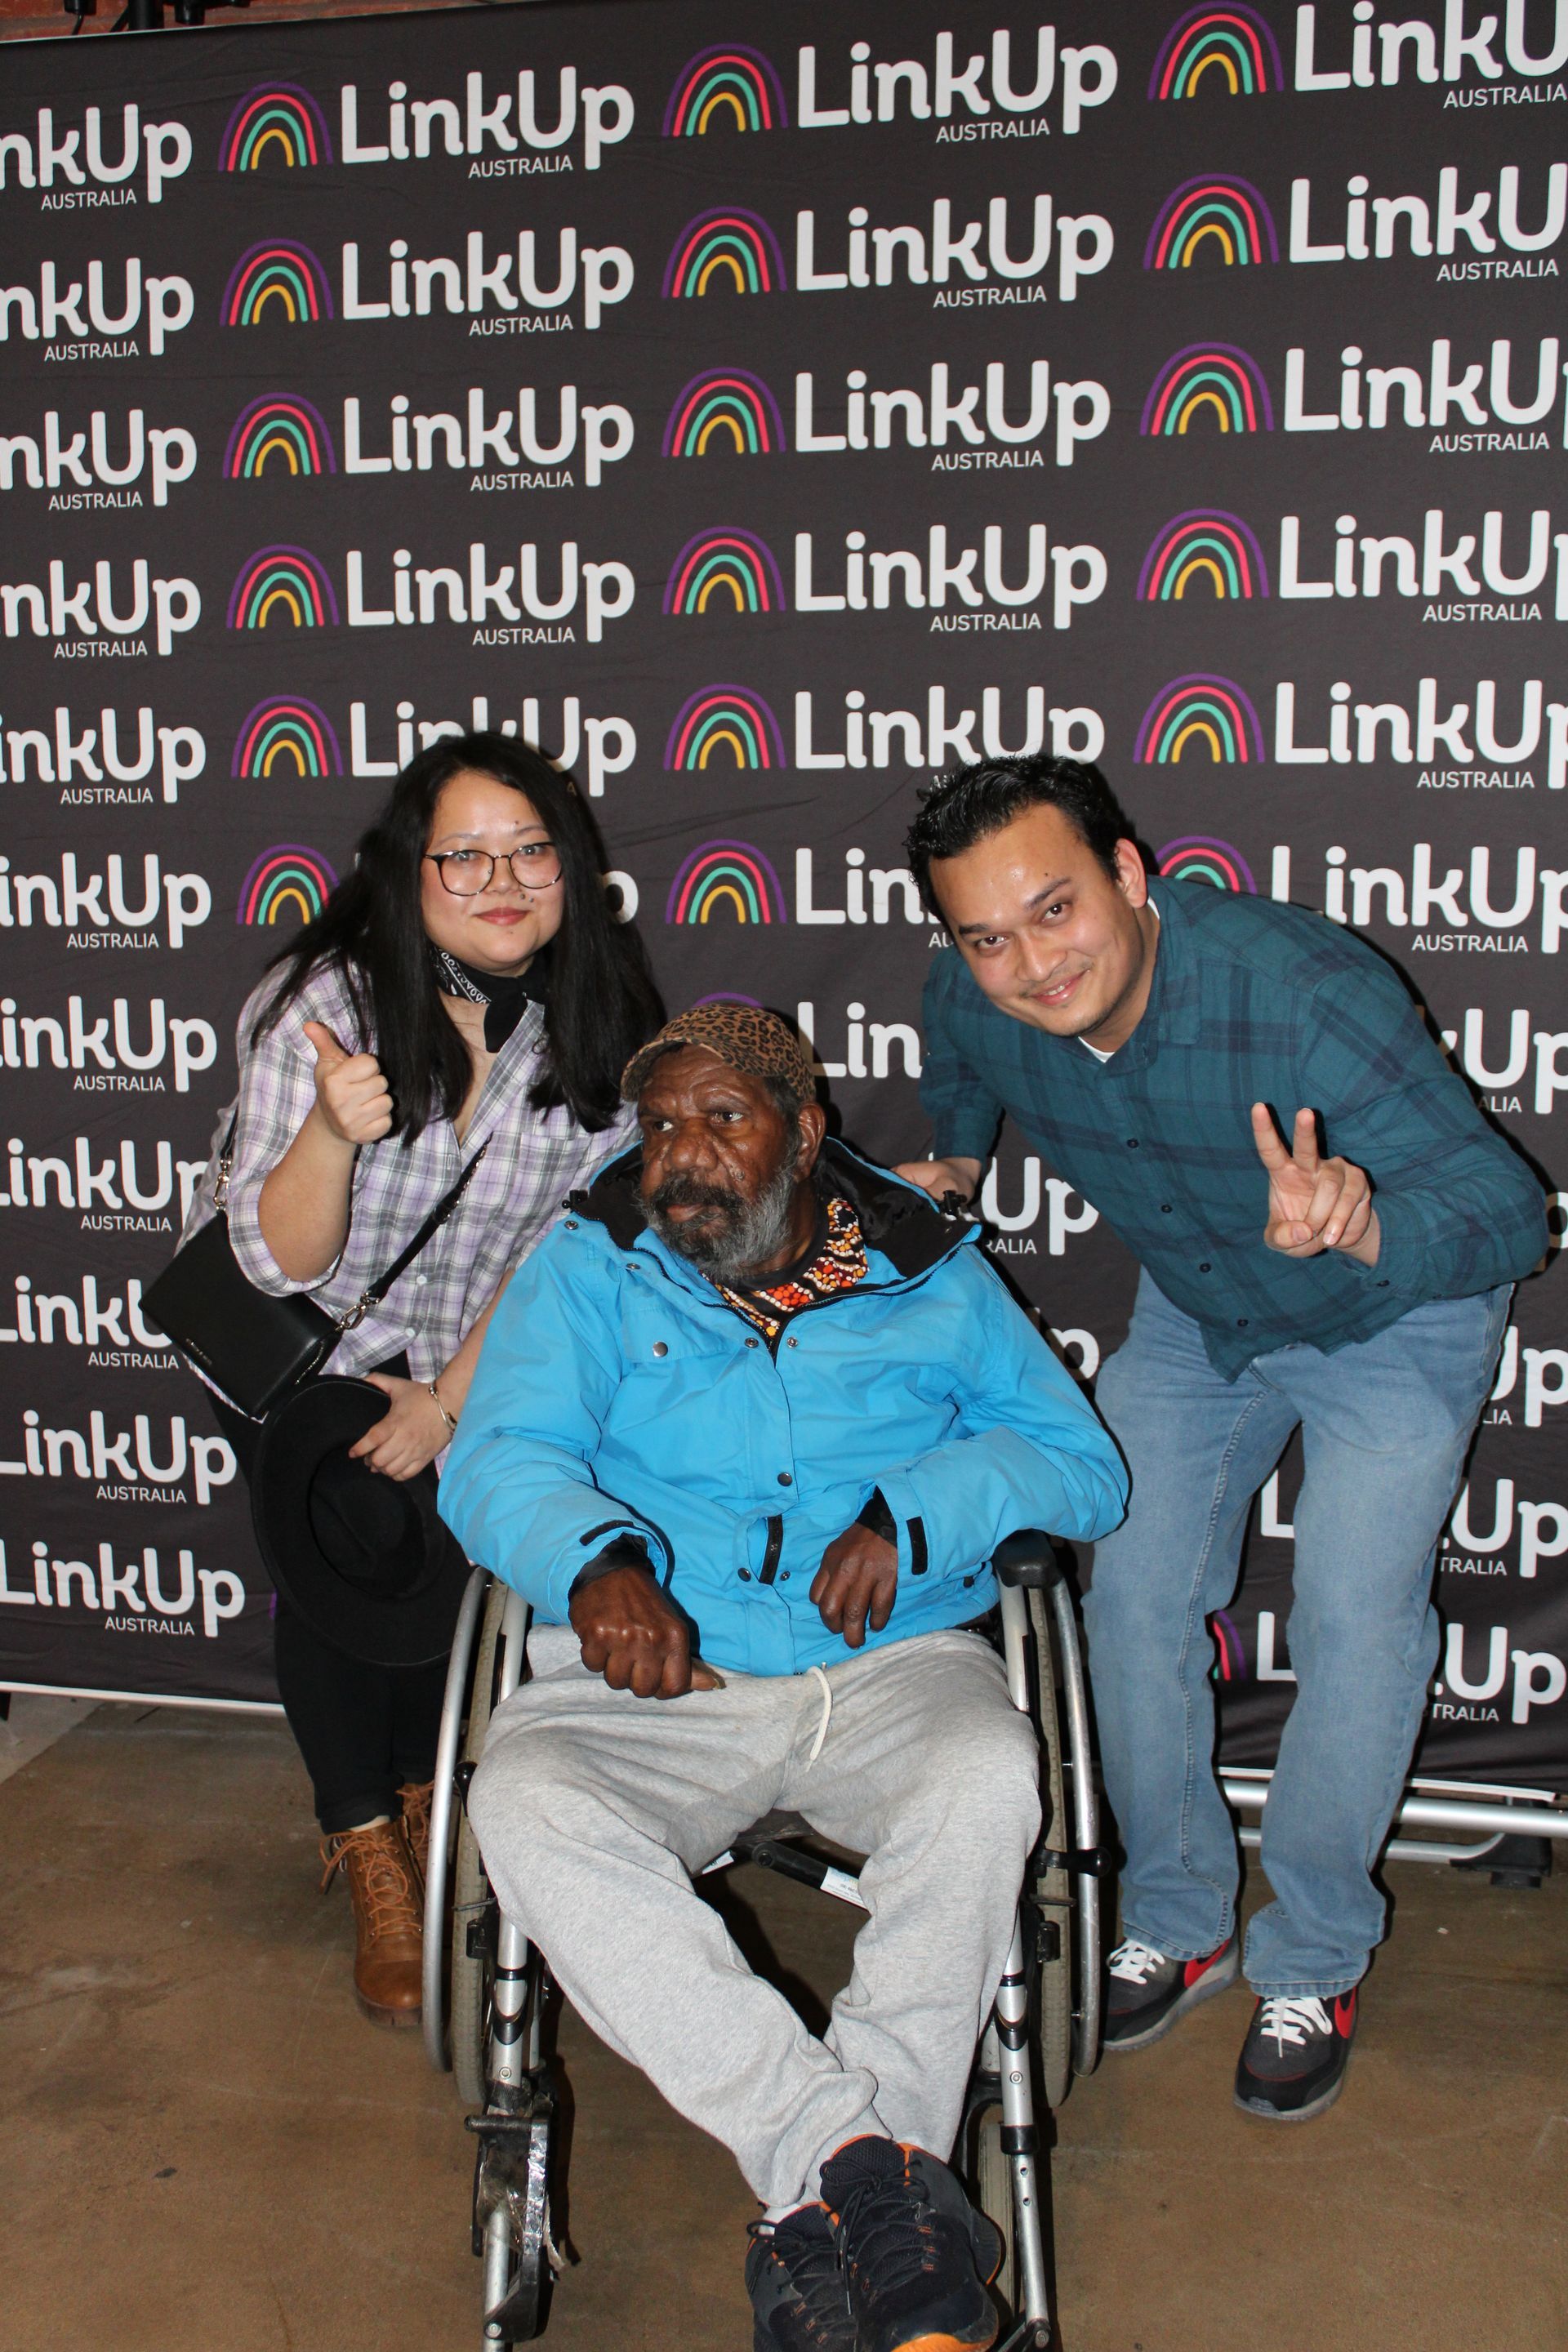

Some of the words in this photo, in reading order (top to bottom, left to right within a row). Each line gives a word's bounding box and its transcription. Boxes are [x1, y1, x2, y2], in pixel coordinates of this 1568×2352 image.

[1295, 0, 1568, 91] LinkU
[799, 26, 1117, 134] LinkUp
[1443, 83, 1568, 109] AUSTRALIA
[341, 67, 634, 170] LinkUp
[935, 118, 1050, 143] AUSTRALIA
[0, 104, 192, 203] nkUp
[468, 154, 573, 178] AUSTRALIA
[41, 189, 137, 210] AUSTRALIA
[1290, 163, 1568, 263] LinkU
[797, 194, 1114, 301] LinkUp
[343, 228, 634, 329] LinkUp
[1437, 258, 1559, 282] AUSTRALIA
[0, 258, 194, 355] nkUp
[933, 286, 1047, 308] AUSTRALIA
[469, 314, 573, 336] AUSTRALIA
[44, 341, 139, 361] AUSTRALIA
[1285, 337, 1568, 452] LinkU
[796, 360, 1110, 466] LinkUp
[344, 385, 634, 487] LinkUp
[1429, 431, 1550, 452] AUSTRALIA
[0, 409, 197, 506] nkUp
[931, 450, 1045, 471] AUSTRALIA
[470, 471, 574, 492] AUSTRALIA
[48, 492, 143, 510] AUSTRALIA
[795, 524, 1107, 629] LinkUp
[1279, 510, 1568, 621] LinkU
[347, 542, 635, 642] LinkUp
[0, 559, 201, 656] nkUp
[1423, 604, 1543, 622] AUSTRALIA
[929, 612, 1042, 632] AUSTRALIA
[472, 626, 576, 645] AUSTRALIA
[54, 640, 148, 658] AUSTRALIA
[795, 686, 1105, 768] LinkUp
[0, 707, 206, 803] nkUp
[1416, 771, 1535, 789] AUSTRALIA
[60, 788, 154, 804] AUSTRALIA
[796, 848, 941, 924] Lin
[0, 851, 212, 948] inkUp
[66, 933, 159, 949] AUSTRALIA
[1411, 934, 1530, 952] AUSTRALIA
[0, 996, 216, 1092] inkUp
[798, 1002, 923, 1078] Lin
[74, 1075, 166, 1092] AUSTRALIA
[80, 1215, 172, 1232] AUSTRALIA
[87, 1352, 179, 1370] AUSTRALIA
[96, 1486, 187, 1503] AUSTRALIA
[1441, 1557, 1508, 1575] TRALIA
[105, 1616, 195, 1636] AUSTRALIA
[1433, 1703, 1499, 1722] TRALIA
